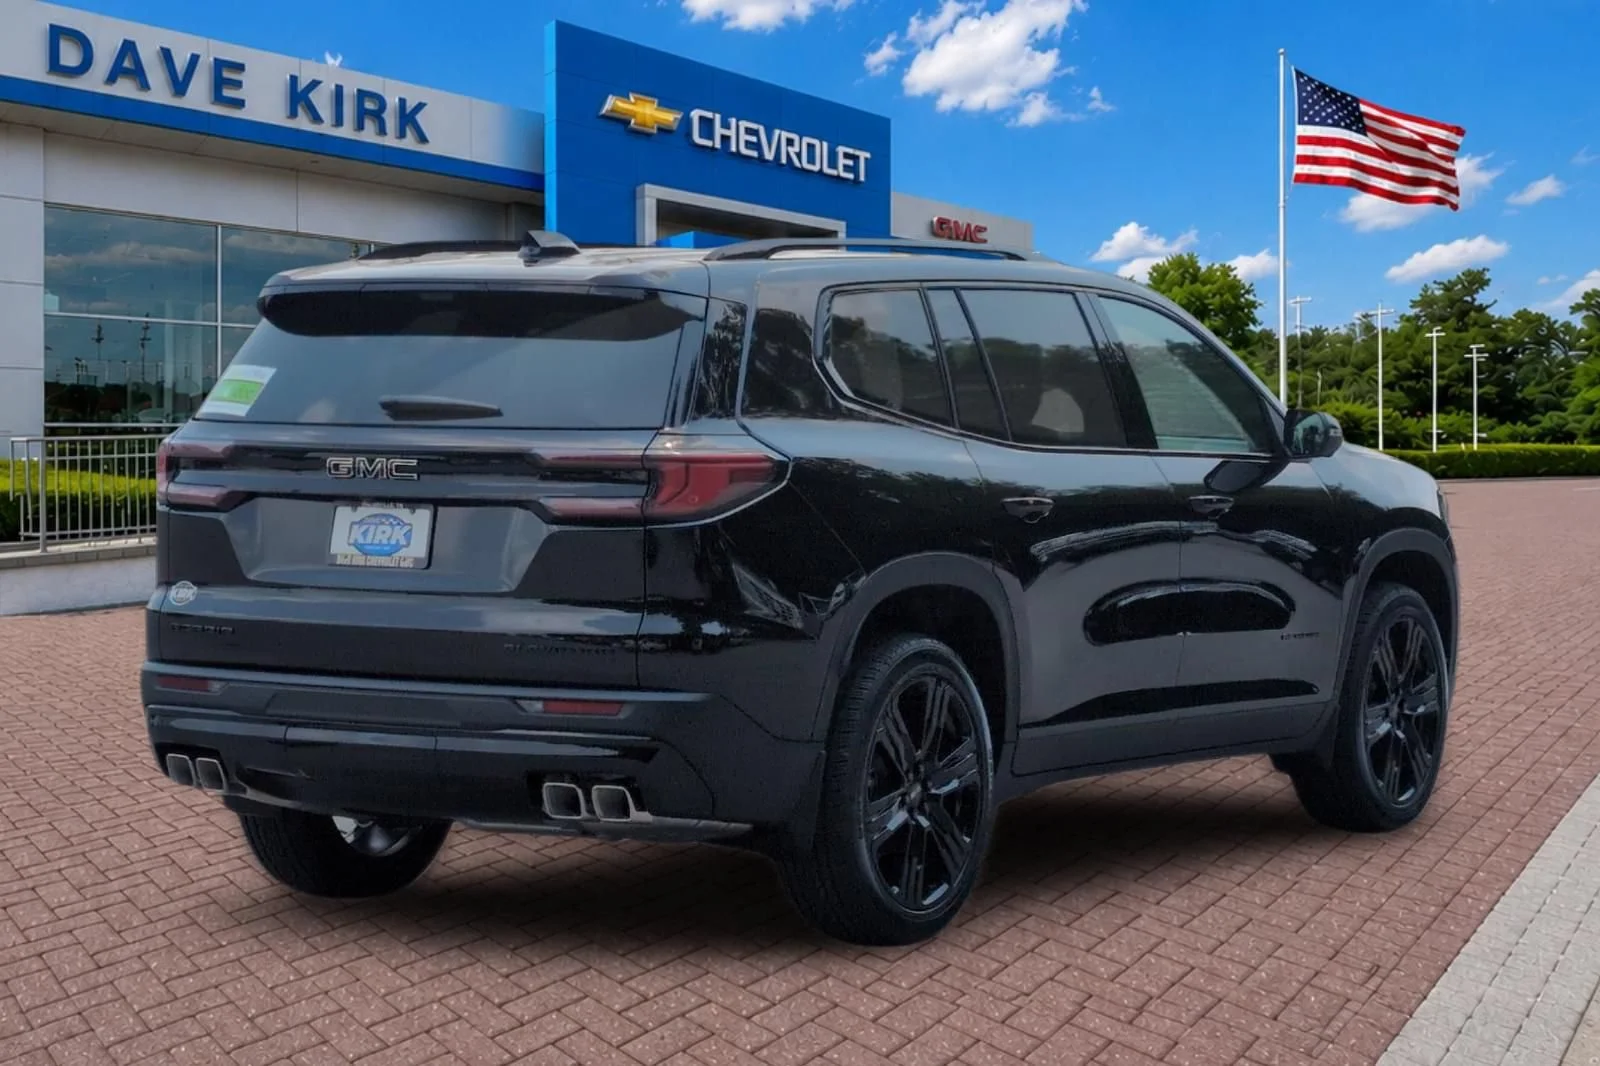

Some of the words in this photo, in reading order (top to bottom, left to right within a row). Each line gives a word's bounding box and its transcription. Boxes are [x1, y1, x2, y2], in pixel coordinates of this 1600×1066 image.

[48, 22, 247, 110] DAVE
[286, 73, 430, 144] KIRK
[690, 108, 871, 183] CHEVROLET
[932, 216, 988, 244] GMC
[326, 457, 418, 480] GMC
[348, 523, 412, 546] KIRK
